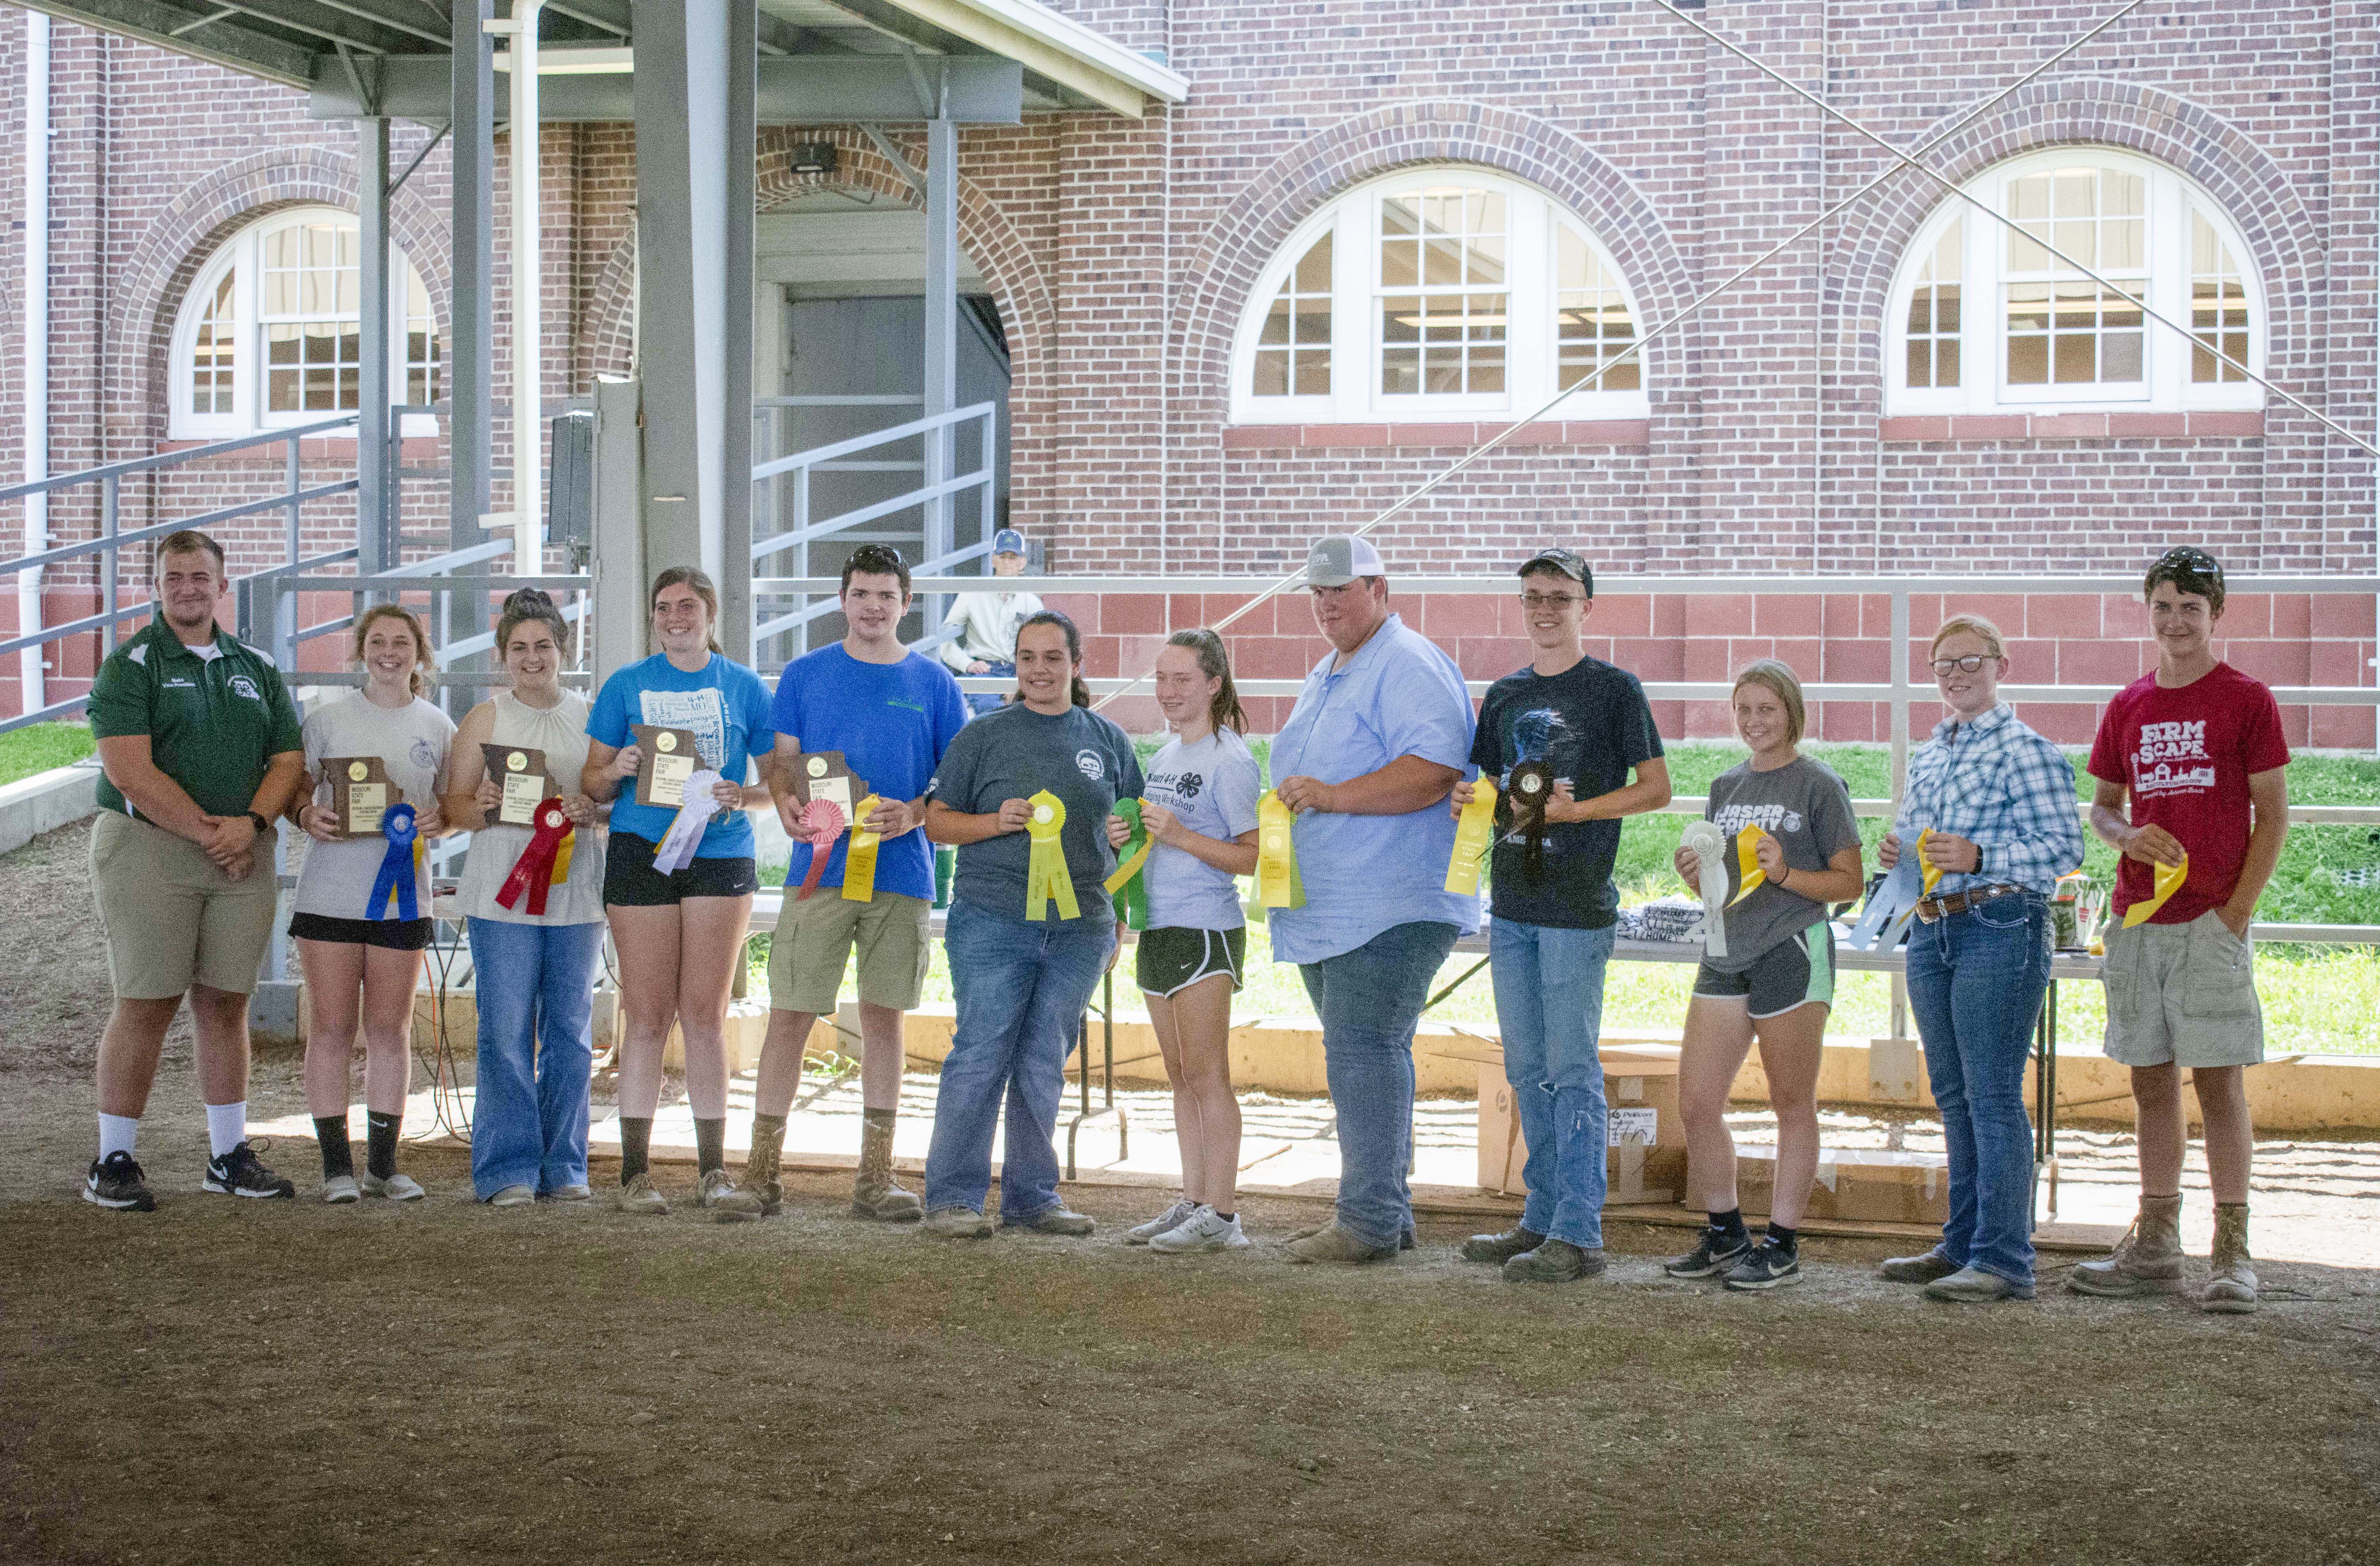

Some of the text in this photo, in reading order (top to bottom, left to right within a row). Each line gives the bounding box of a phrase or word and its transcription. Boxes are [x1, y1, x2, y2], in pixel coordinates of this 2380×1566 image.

[691, 702, 706, 711] MO
[2140, 720, 2207, 744] FARM
[2140, 740, 2204, 765] SCAPE
[1164, 772, 1178, 785] 4-H
[1161, 793, 1195, 814] Workshop
[1719, 804, 1785, 819] JASPER
